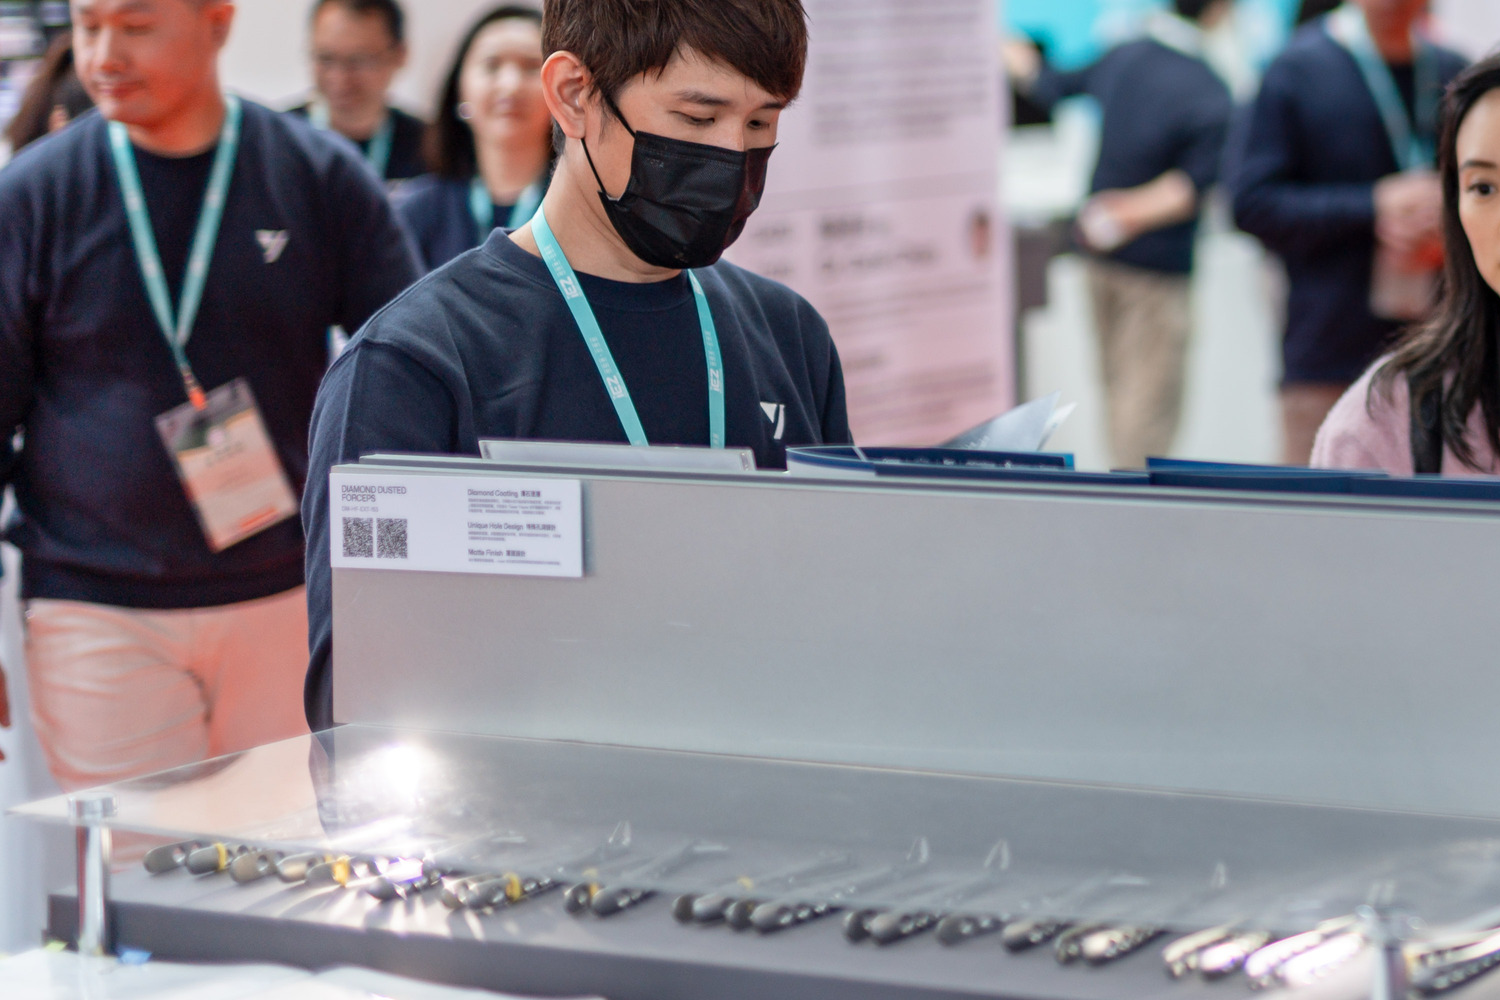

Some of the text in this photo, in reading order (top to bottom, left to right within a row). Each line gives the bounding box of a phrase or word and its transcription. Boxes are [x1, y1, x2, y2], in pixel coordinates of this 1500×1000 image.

[341, 485, 407, 495] DIAMOND DUSTED
[467, 489, 494, 497] Diamond
[495, 490, 519, 498] Coating
[341, 494, 376, 502] FORCEPS
[467, 522, 488, 530] Unique
[489, 522, 503, 530] Hole
[504, 523, 524, 531] Design
[486, 549, 504, 557] Finish
